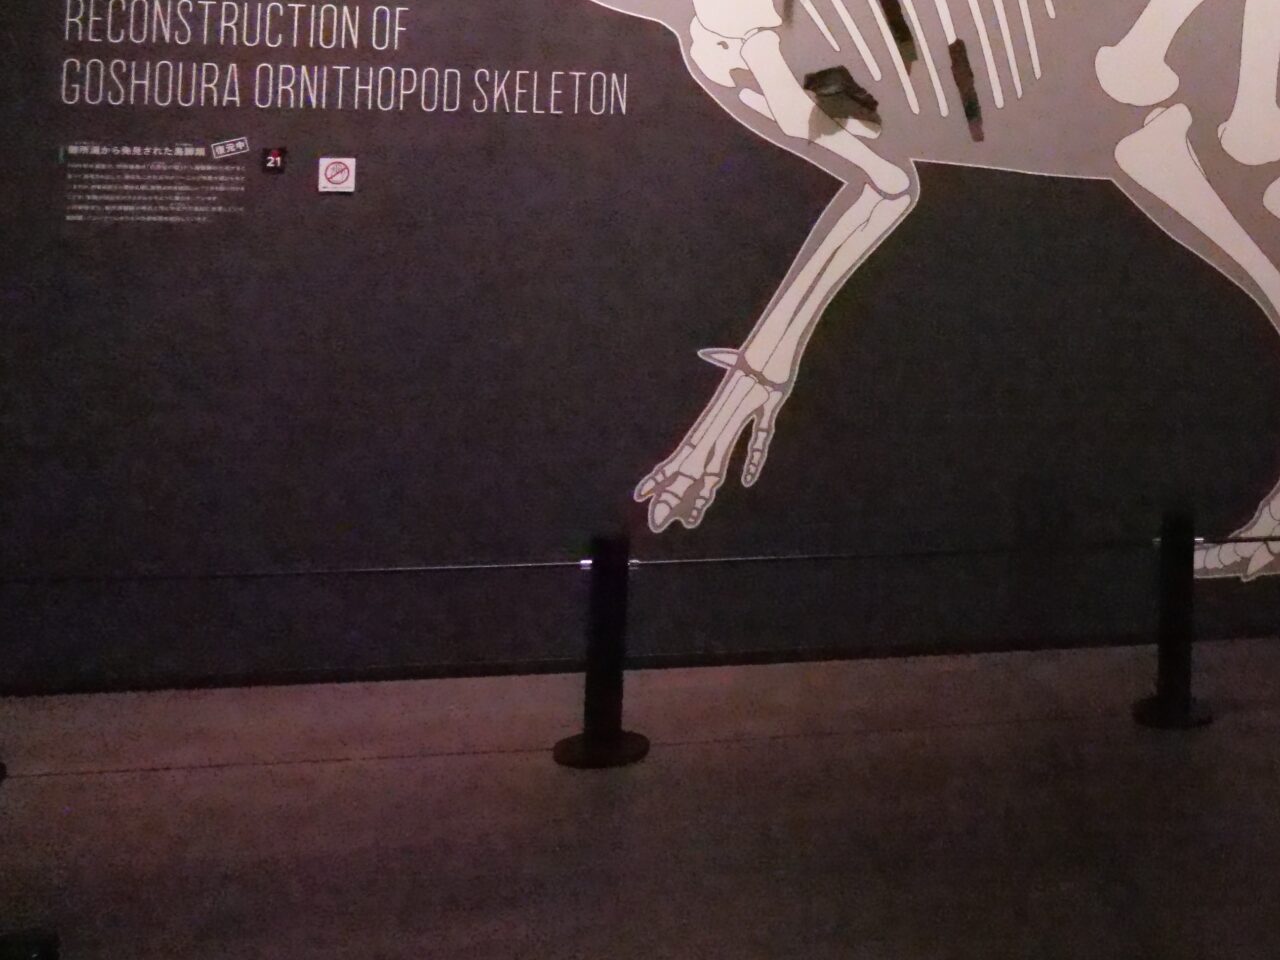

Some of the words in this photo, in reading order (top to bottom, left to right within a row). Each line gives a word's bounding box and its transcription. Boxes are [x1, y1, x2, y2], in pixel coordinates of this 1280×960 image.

[371, 6, 410, 51] OF
[61, 58, 241, 109] GOSHOURA
[254, 63, 461, 113] ORNITHOPOD
[471, 68, 629, 116] SKELETON
[266, 156, 282, 168] 21
